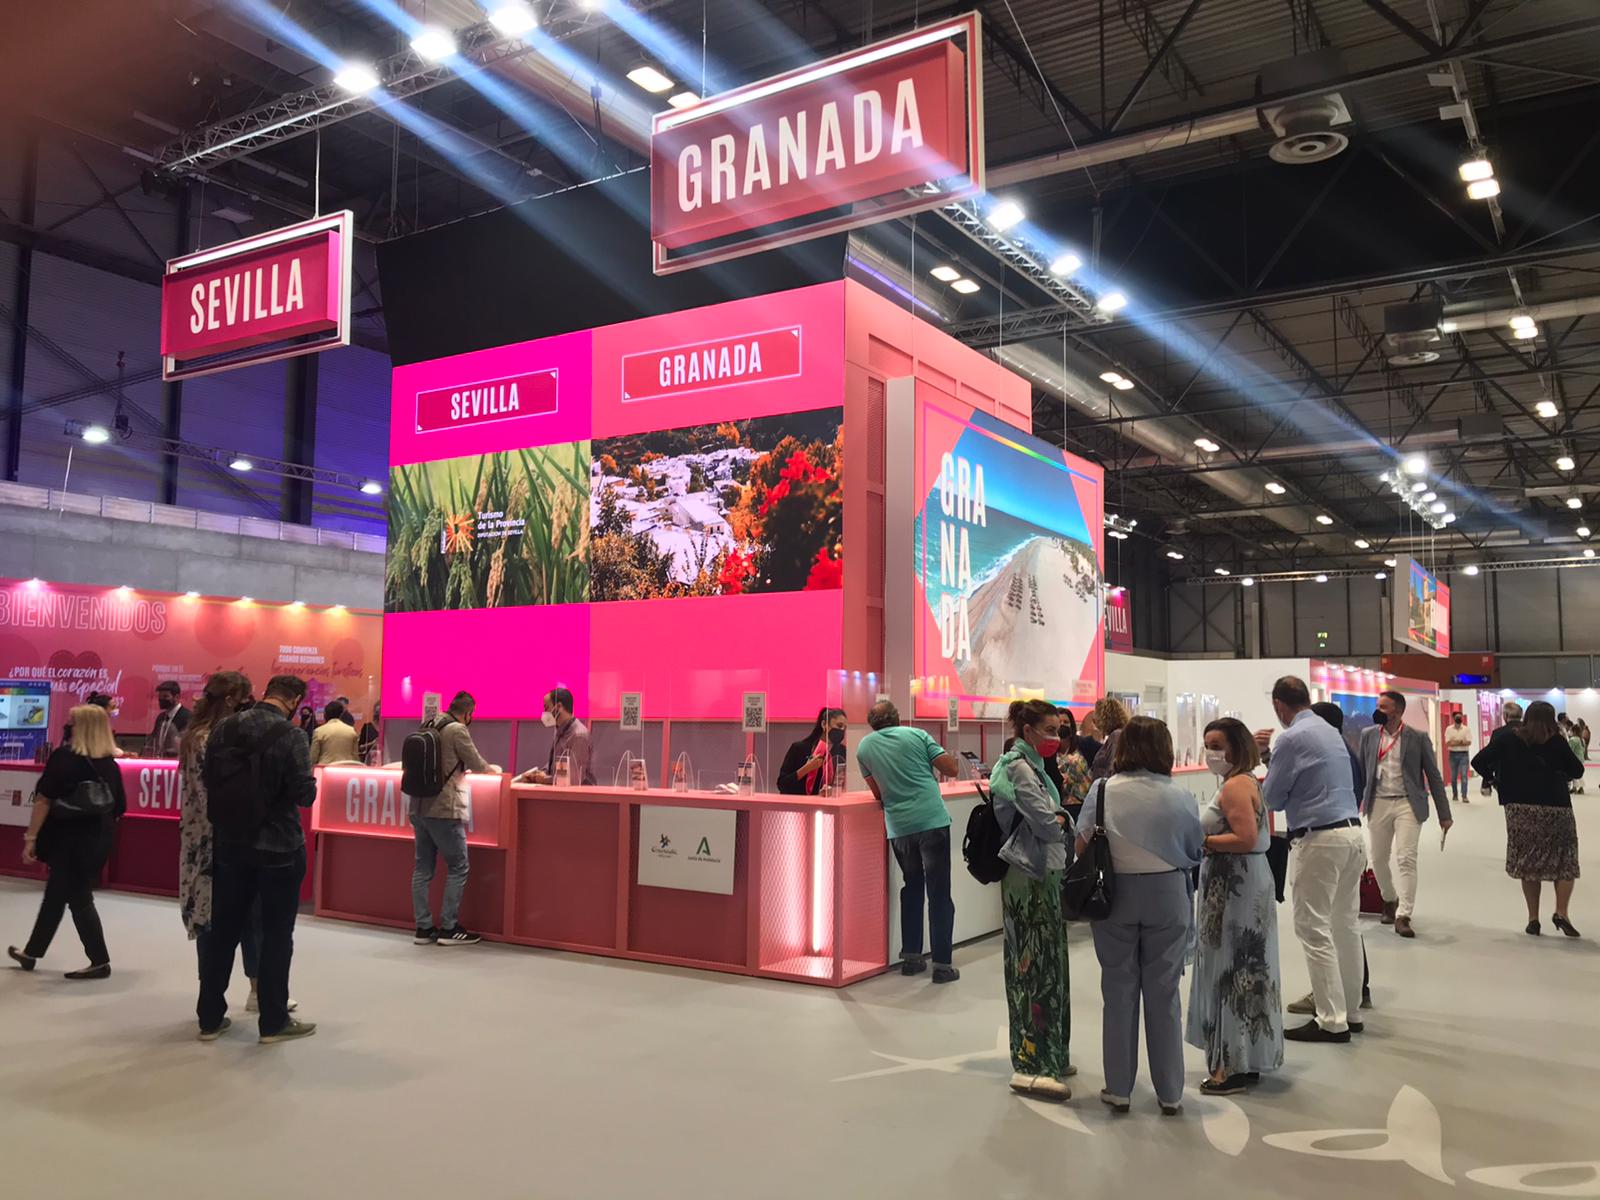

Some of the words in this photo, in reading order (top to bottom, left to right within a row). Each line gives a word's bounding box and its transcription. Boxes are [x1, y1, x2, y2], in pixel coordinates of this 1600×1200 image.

[678, 78, 923, 212] GRANADA
[190, 258, 303, 334] SEVILLA
[659, 341, 762, 387] GRANADA
[451, 383, 519, 420] SEVILLA
[940, 451, 986, 527] GRA
[477, 521, 486, 530] de
[488, 521, 494, 529] la
[496, 518, 525, 528] Provincia
[478, 511, 504, 519] Turismo
[940, 520, 971, 599] NA
[0, 590, 167, 634] BIENVENIDOS
[940, 592, 971, 661] DA
[9, 666, 29, 679] ¿POR
[31, 665, 47, 678] QUÉ
[48, 668, 56, 678] EL
[56, 666, 97, 679] corazón
[69, 669, 122, 702] especial
